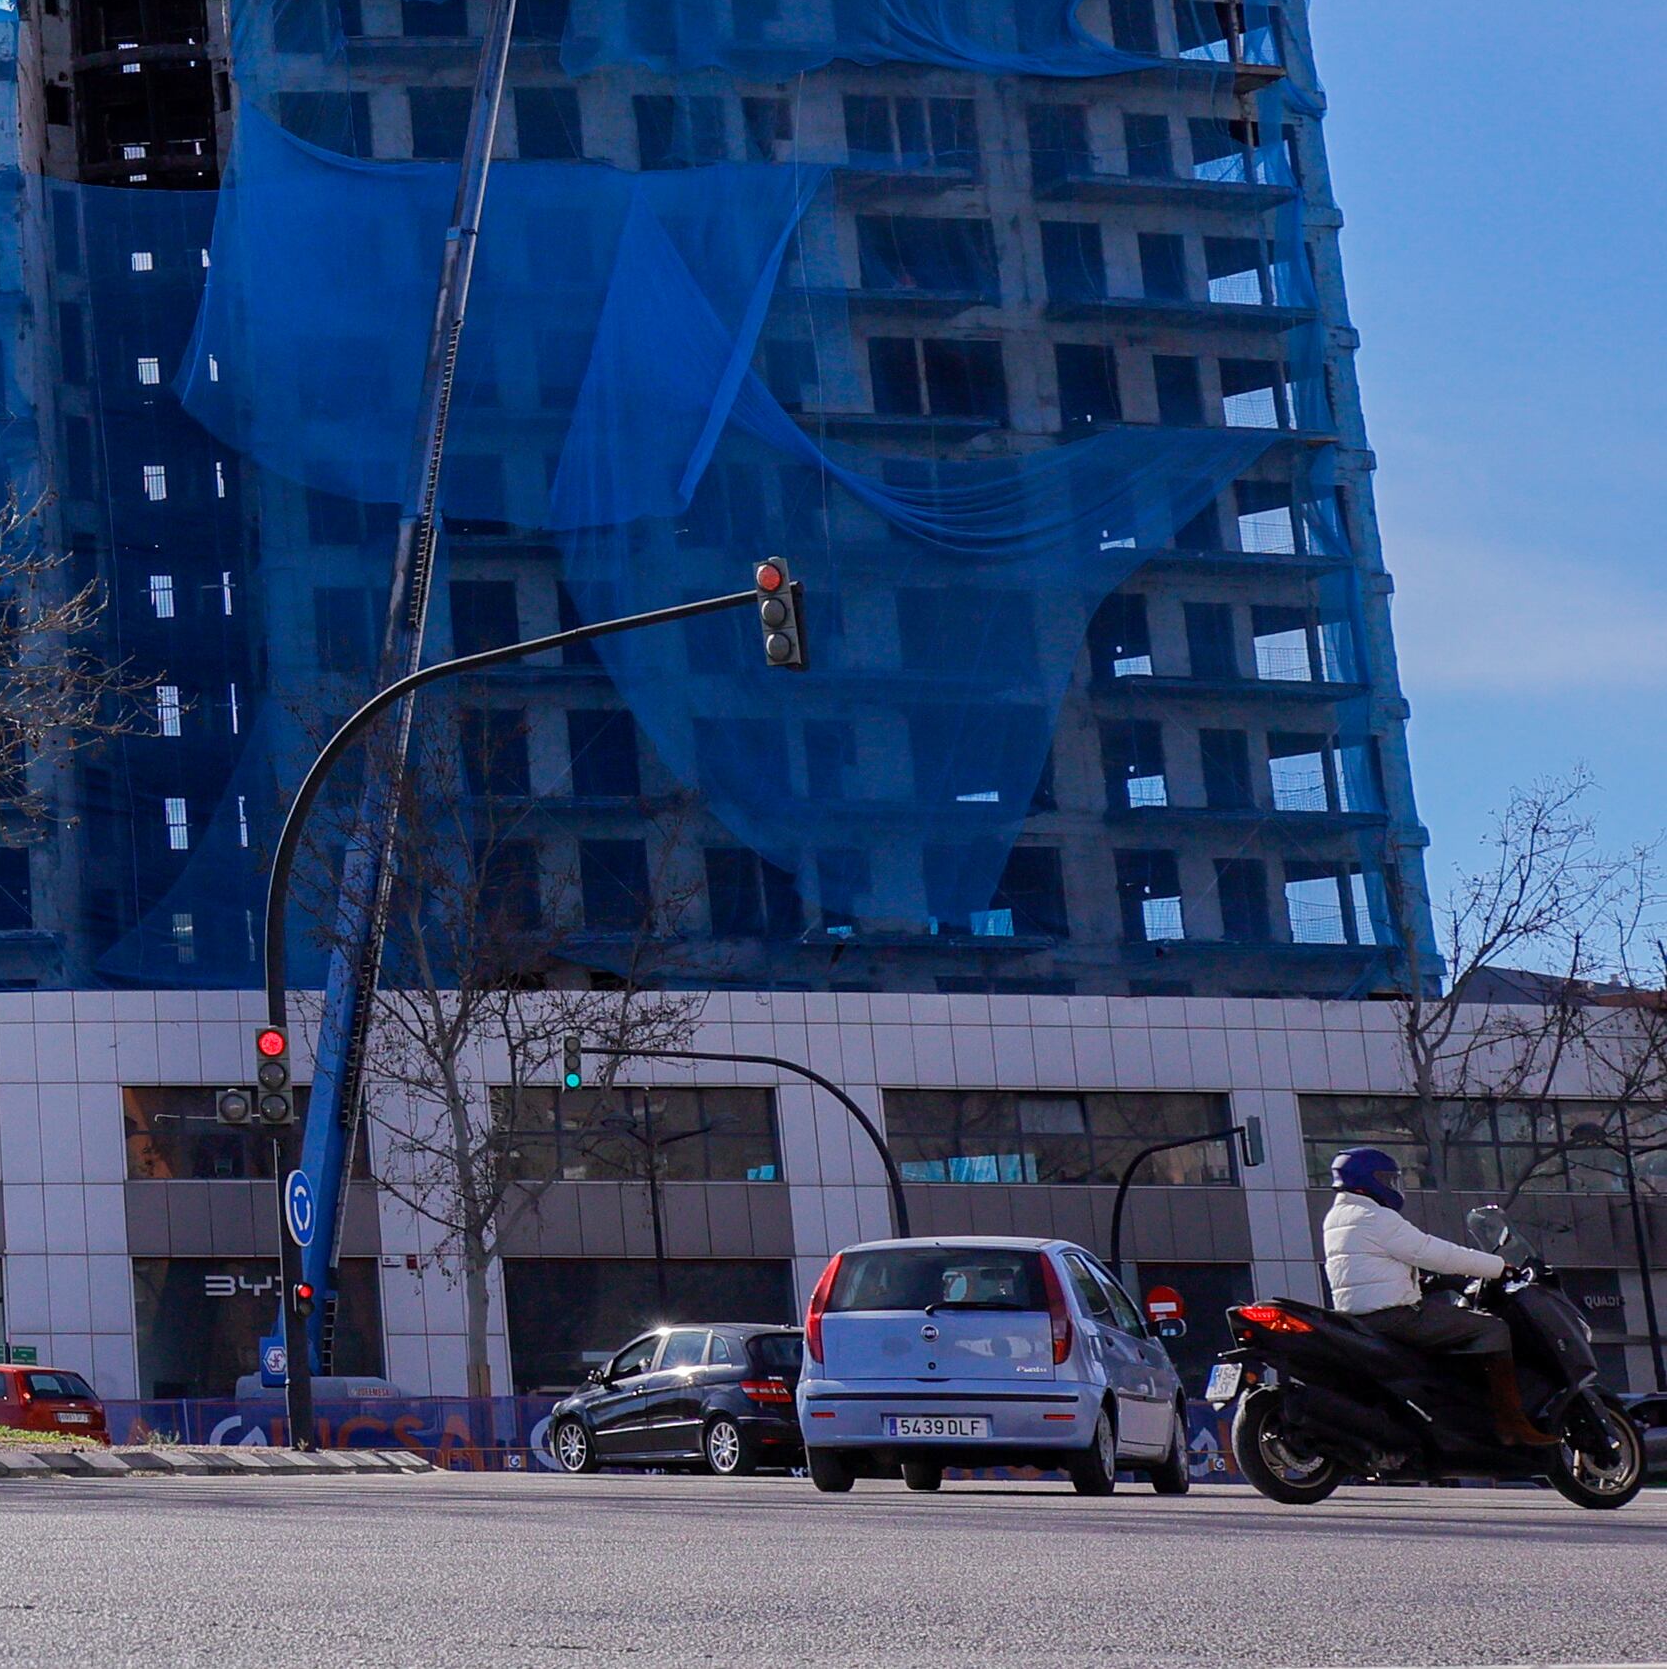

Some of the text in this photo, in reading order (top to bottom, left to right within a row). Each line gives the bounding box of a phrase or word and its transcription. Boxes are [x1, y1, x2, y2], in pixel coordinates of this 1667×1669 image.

[205, 1276, 282, 1296] BY
[900, 1419, 980, 1436] 5439 DLF
